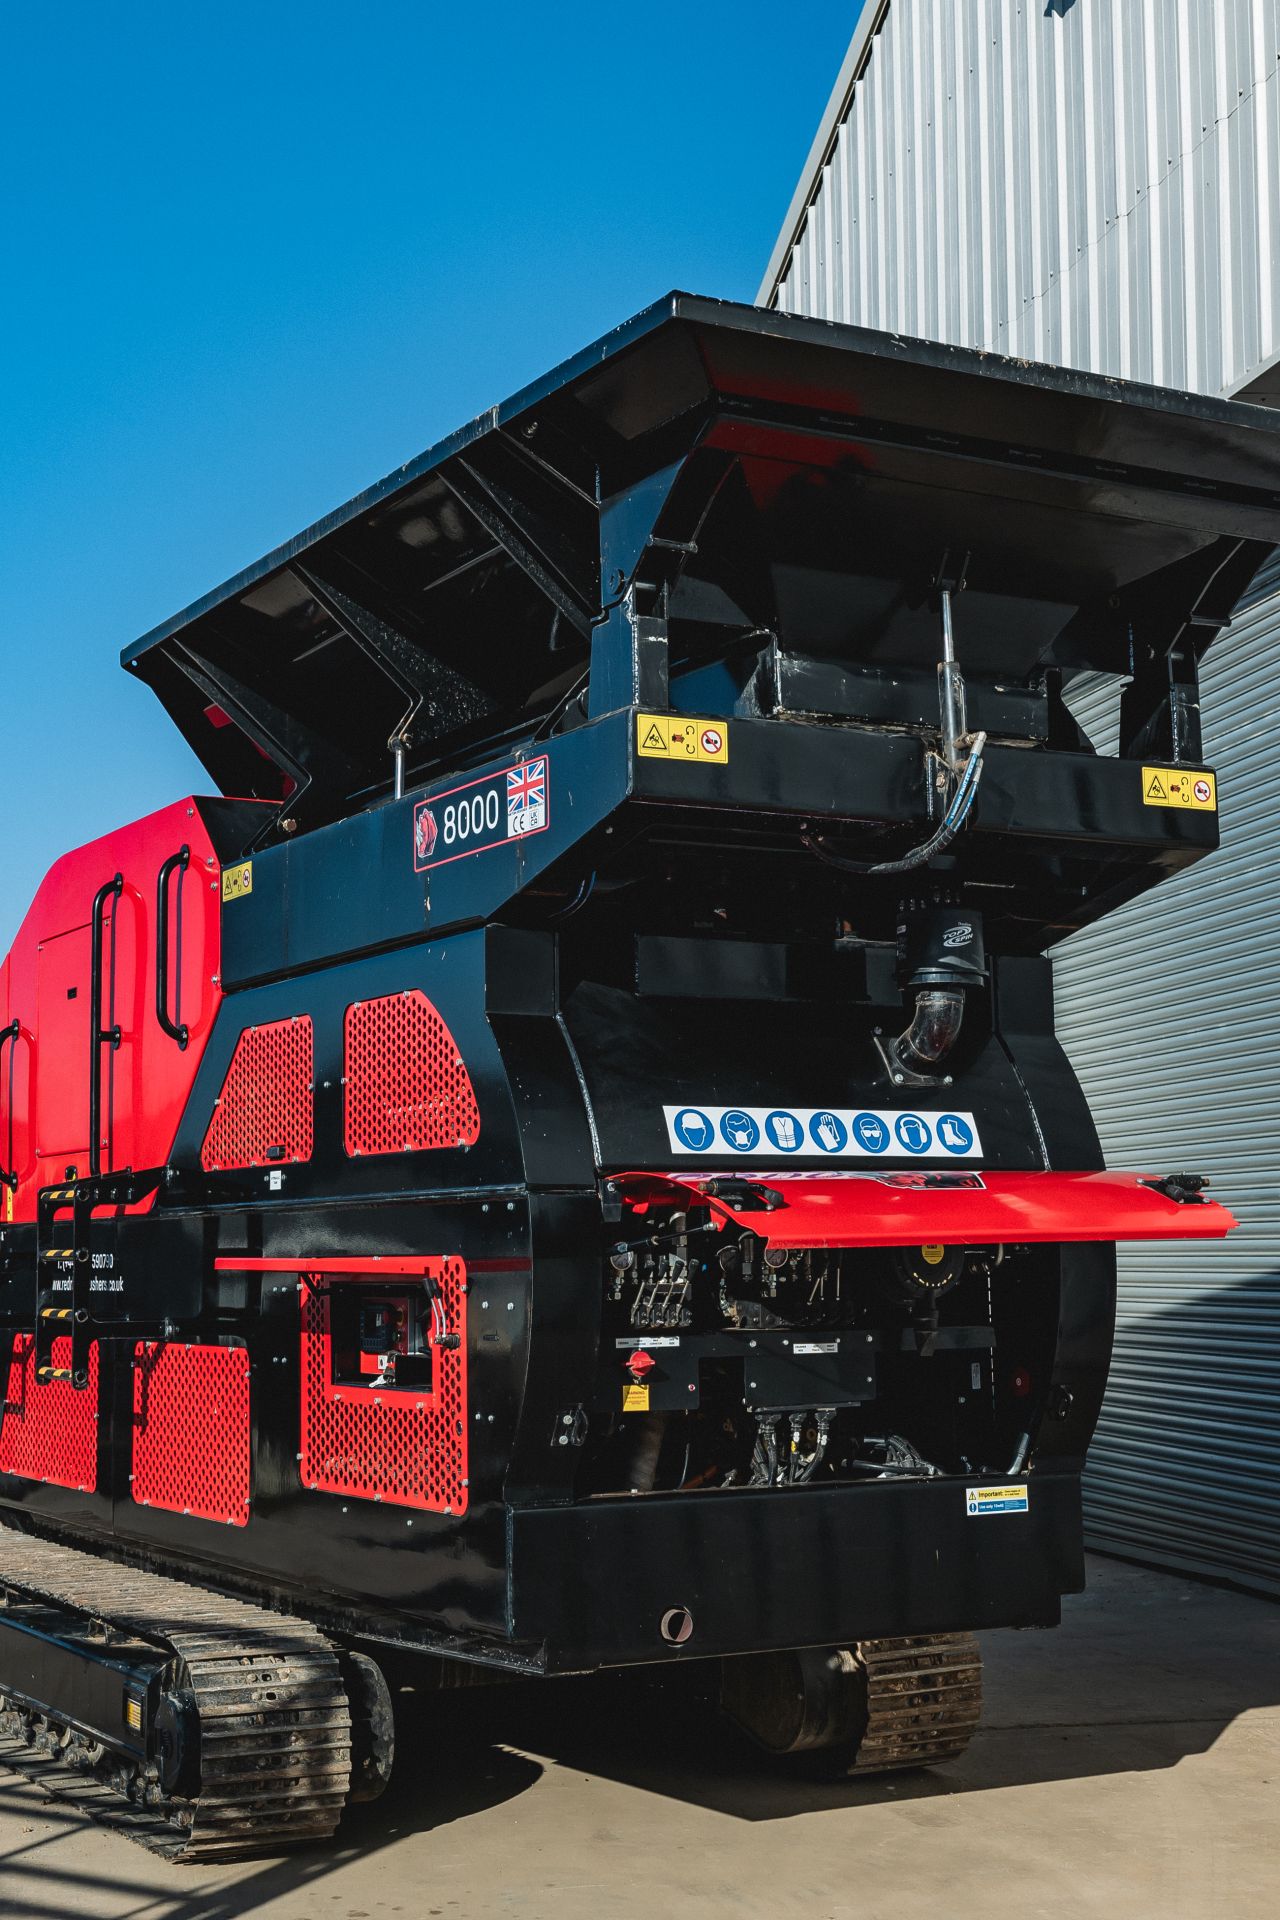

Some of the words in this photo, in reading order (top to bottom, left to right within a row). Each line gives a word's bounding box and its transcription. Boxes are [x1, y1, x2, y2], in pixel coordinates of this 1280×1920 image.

[443, 790, 499, 844] 8000
[512, 813, 525, 833] CE
[943, 929, 963, 940] TOP
[955, 933, 974, 943] SPIN
